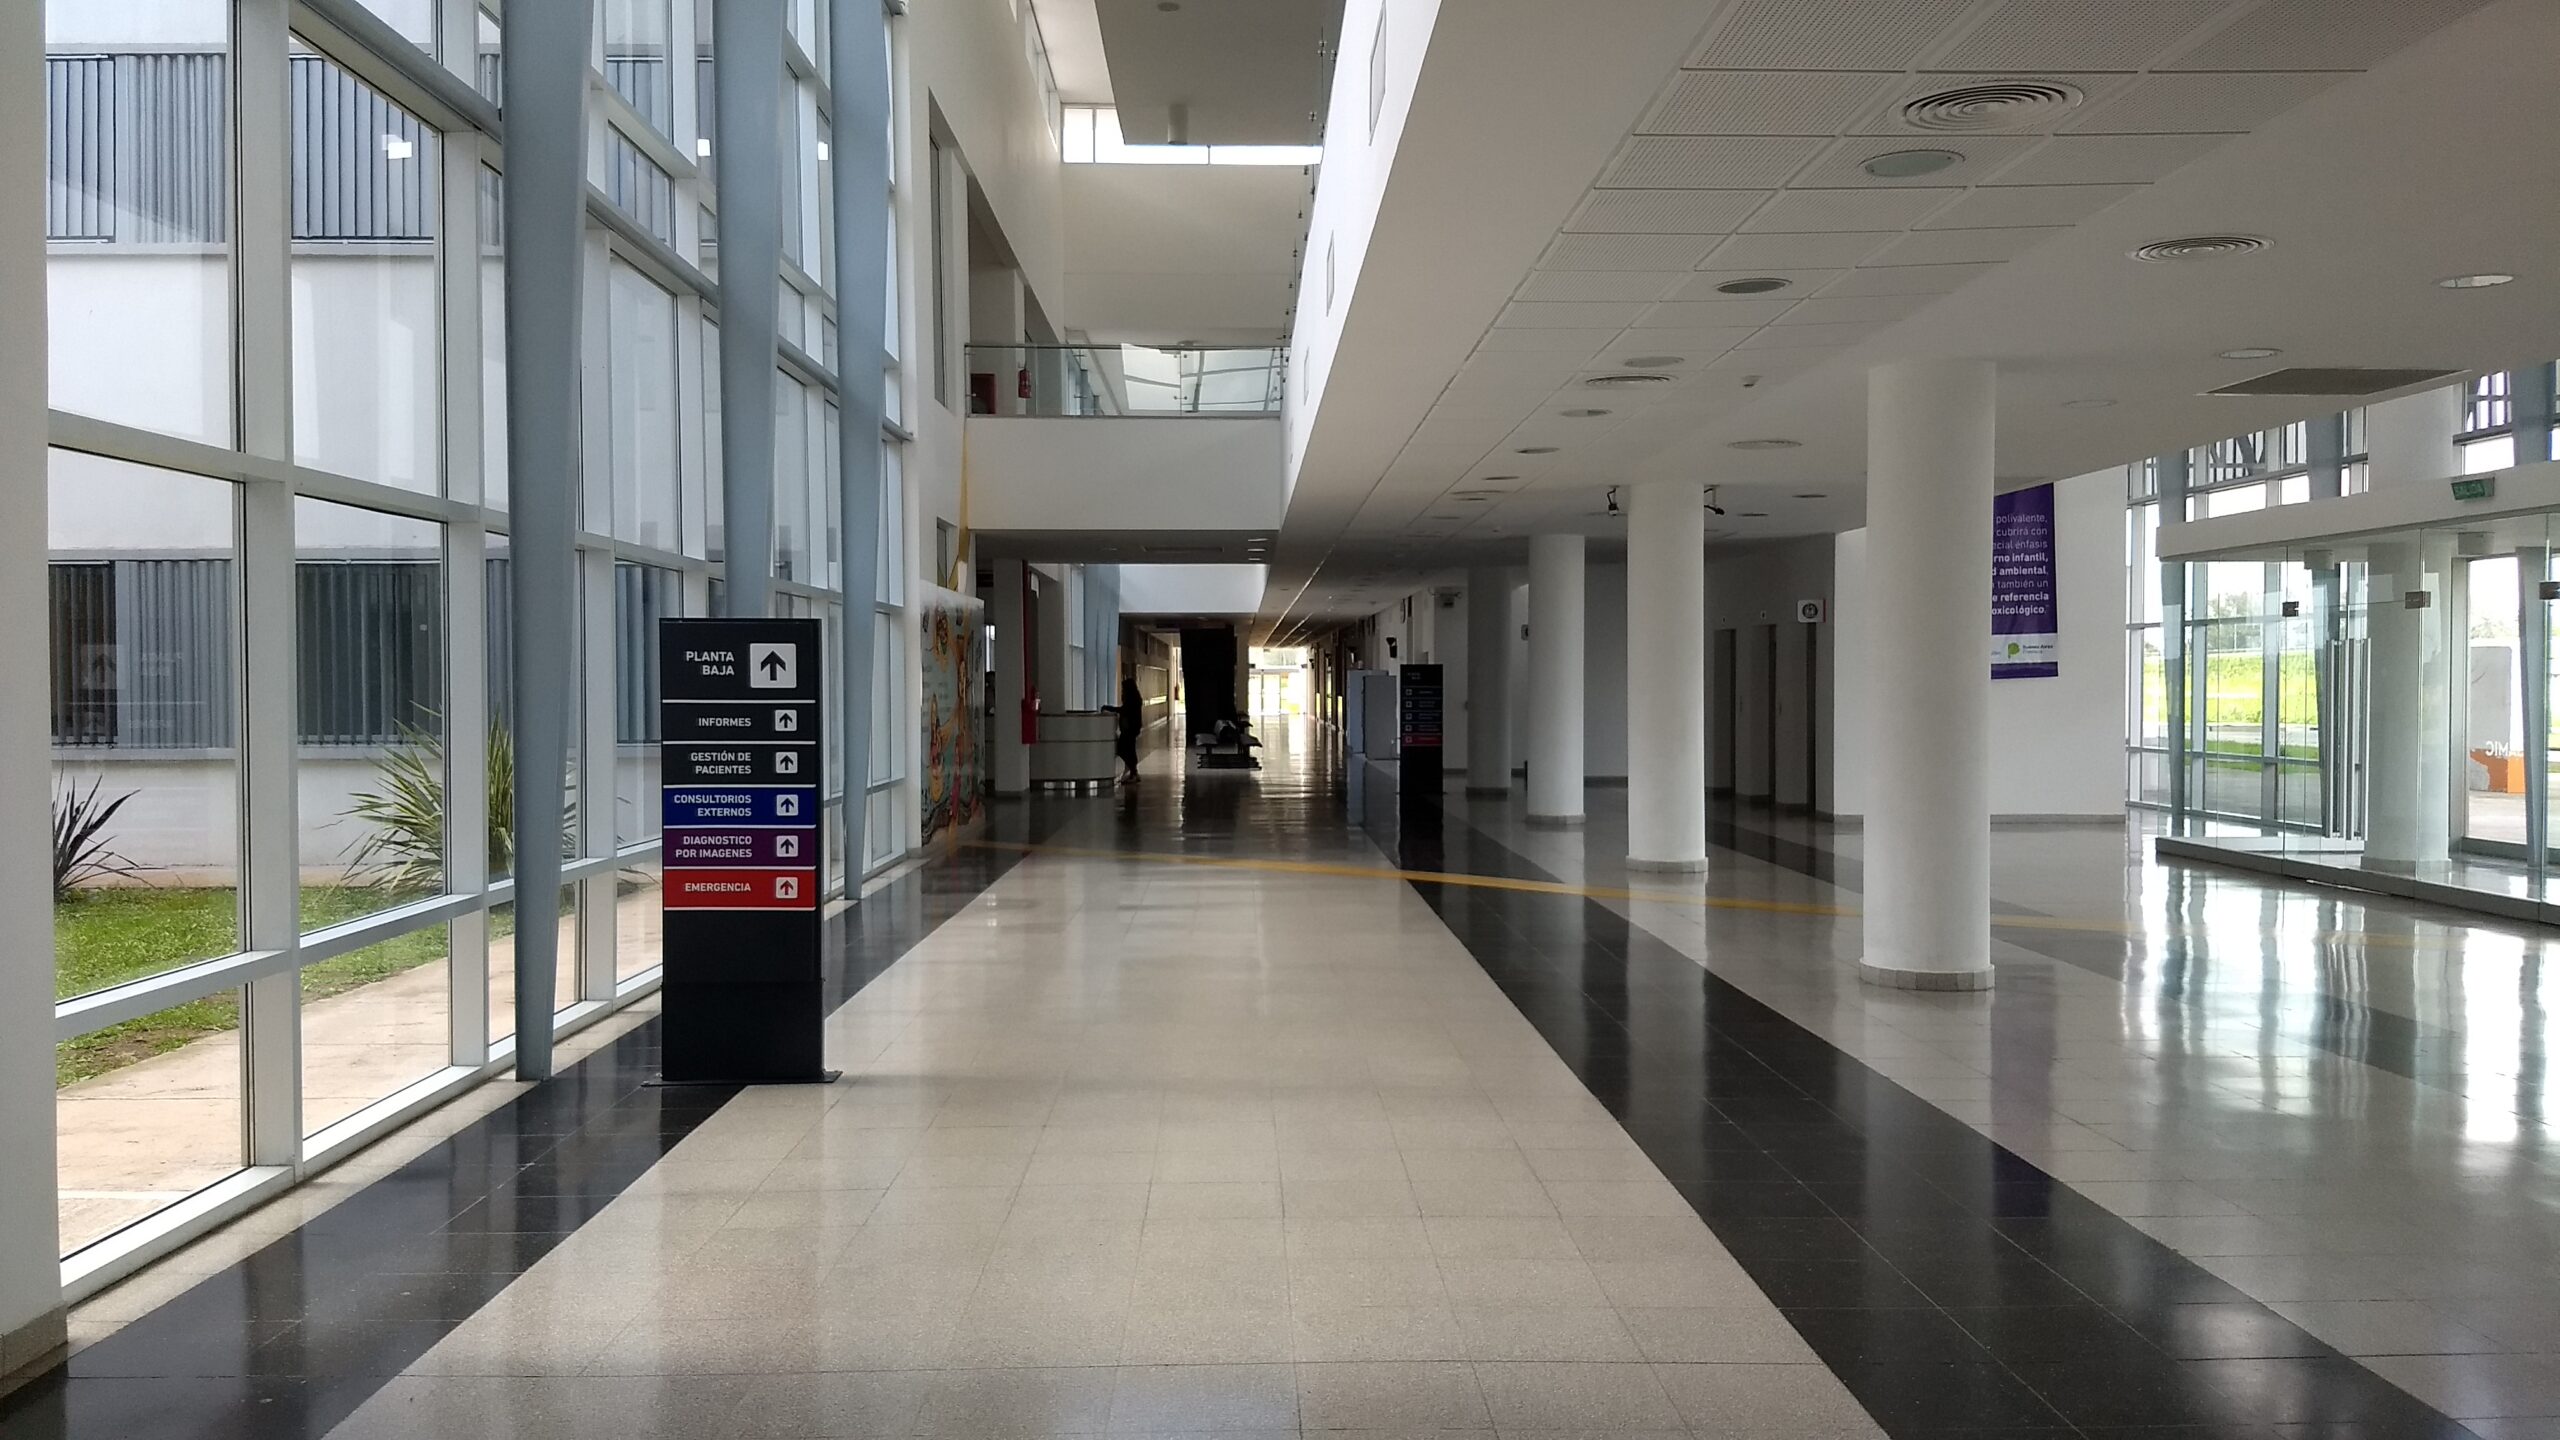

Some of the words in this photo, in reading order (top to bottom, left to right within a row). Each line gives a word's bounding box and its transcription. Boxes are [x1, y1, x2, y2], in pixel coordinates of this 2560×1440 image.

[1996, 527, 2029, 537] cubrirá
[2030, 528, 2048, 536] con
[2012, 553, 2049, 563] infantil,
[1997, 579, 2035, 589] también
[2036, 580, 2049, 588] un
[2000, 592, 2049, 602] referencia
[686, 651, 735, 662] PLANTA
[702, 665, 735, 676] BAJA
[698, 717, 751, 727] INFORMES
[690, 749, 736, 762] GESTIÓN
[737, 752, 751, 761] DE
[695, 765, 752, 774] PACIENTES
[674, 794, 752, 804] CONSULTORIOS
[697, 807, 752, 817] EXTERNOS
[683, 835, 752, 845] DIAGNOSTICO
[676, 849, 697, 858] POR
[699, 848, 752, 858] IMAGENES
[685, 882, 751, 892] EMERGENCIA
